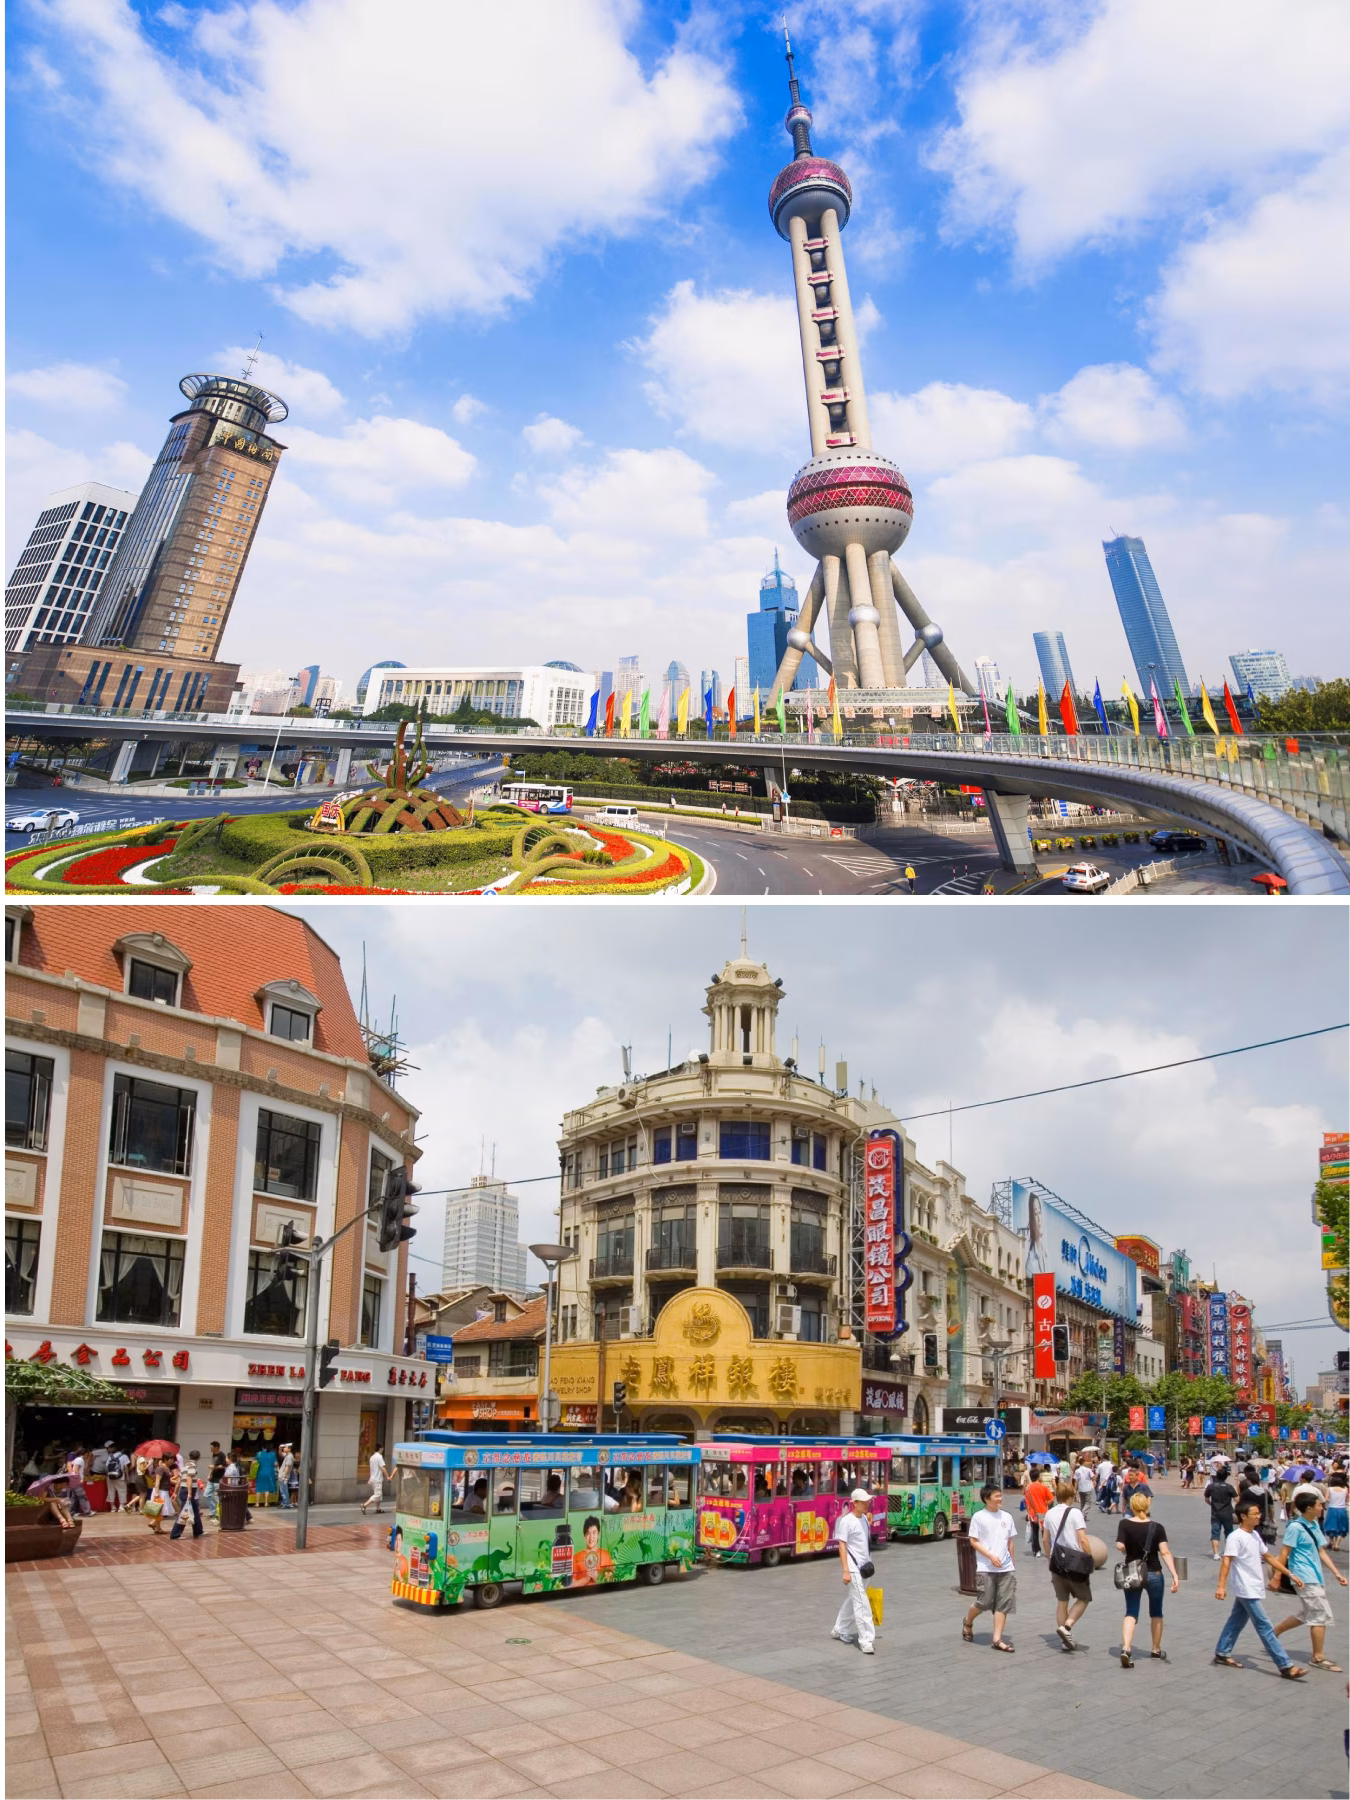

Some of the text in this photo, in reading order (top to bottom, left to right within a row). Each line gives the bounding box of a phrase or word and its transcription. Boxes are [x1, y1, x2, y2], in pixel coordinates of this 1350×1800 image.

[868, 1174, 891, 1306] 茂昌眼镜公司
[1038, 1318, 1053, 1352] 古今
[248, 1363, 285, 1376] ZHEN
[340, 1370, 371, 1382] FANG
[577, 1376, 595, 1384] XIANG
[576, 1386, 592, 1394] SHOP
[479, 1408, 497, 1418] SHOP
[431, 1501, 439, 1513] 8
